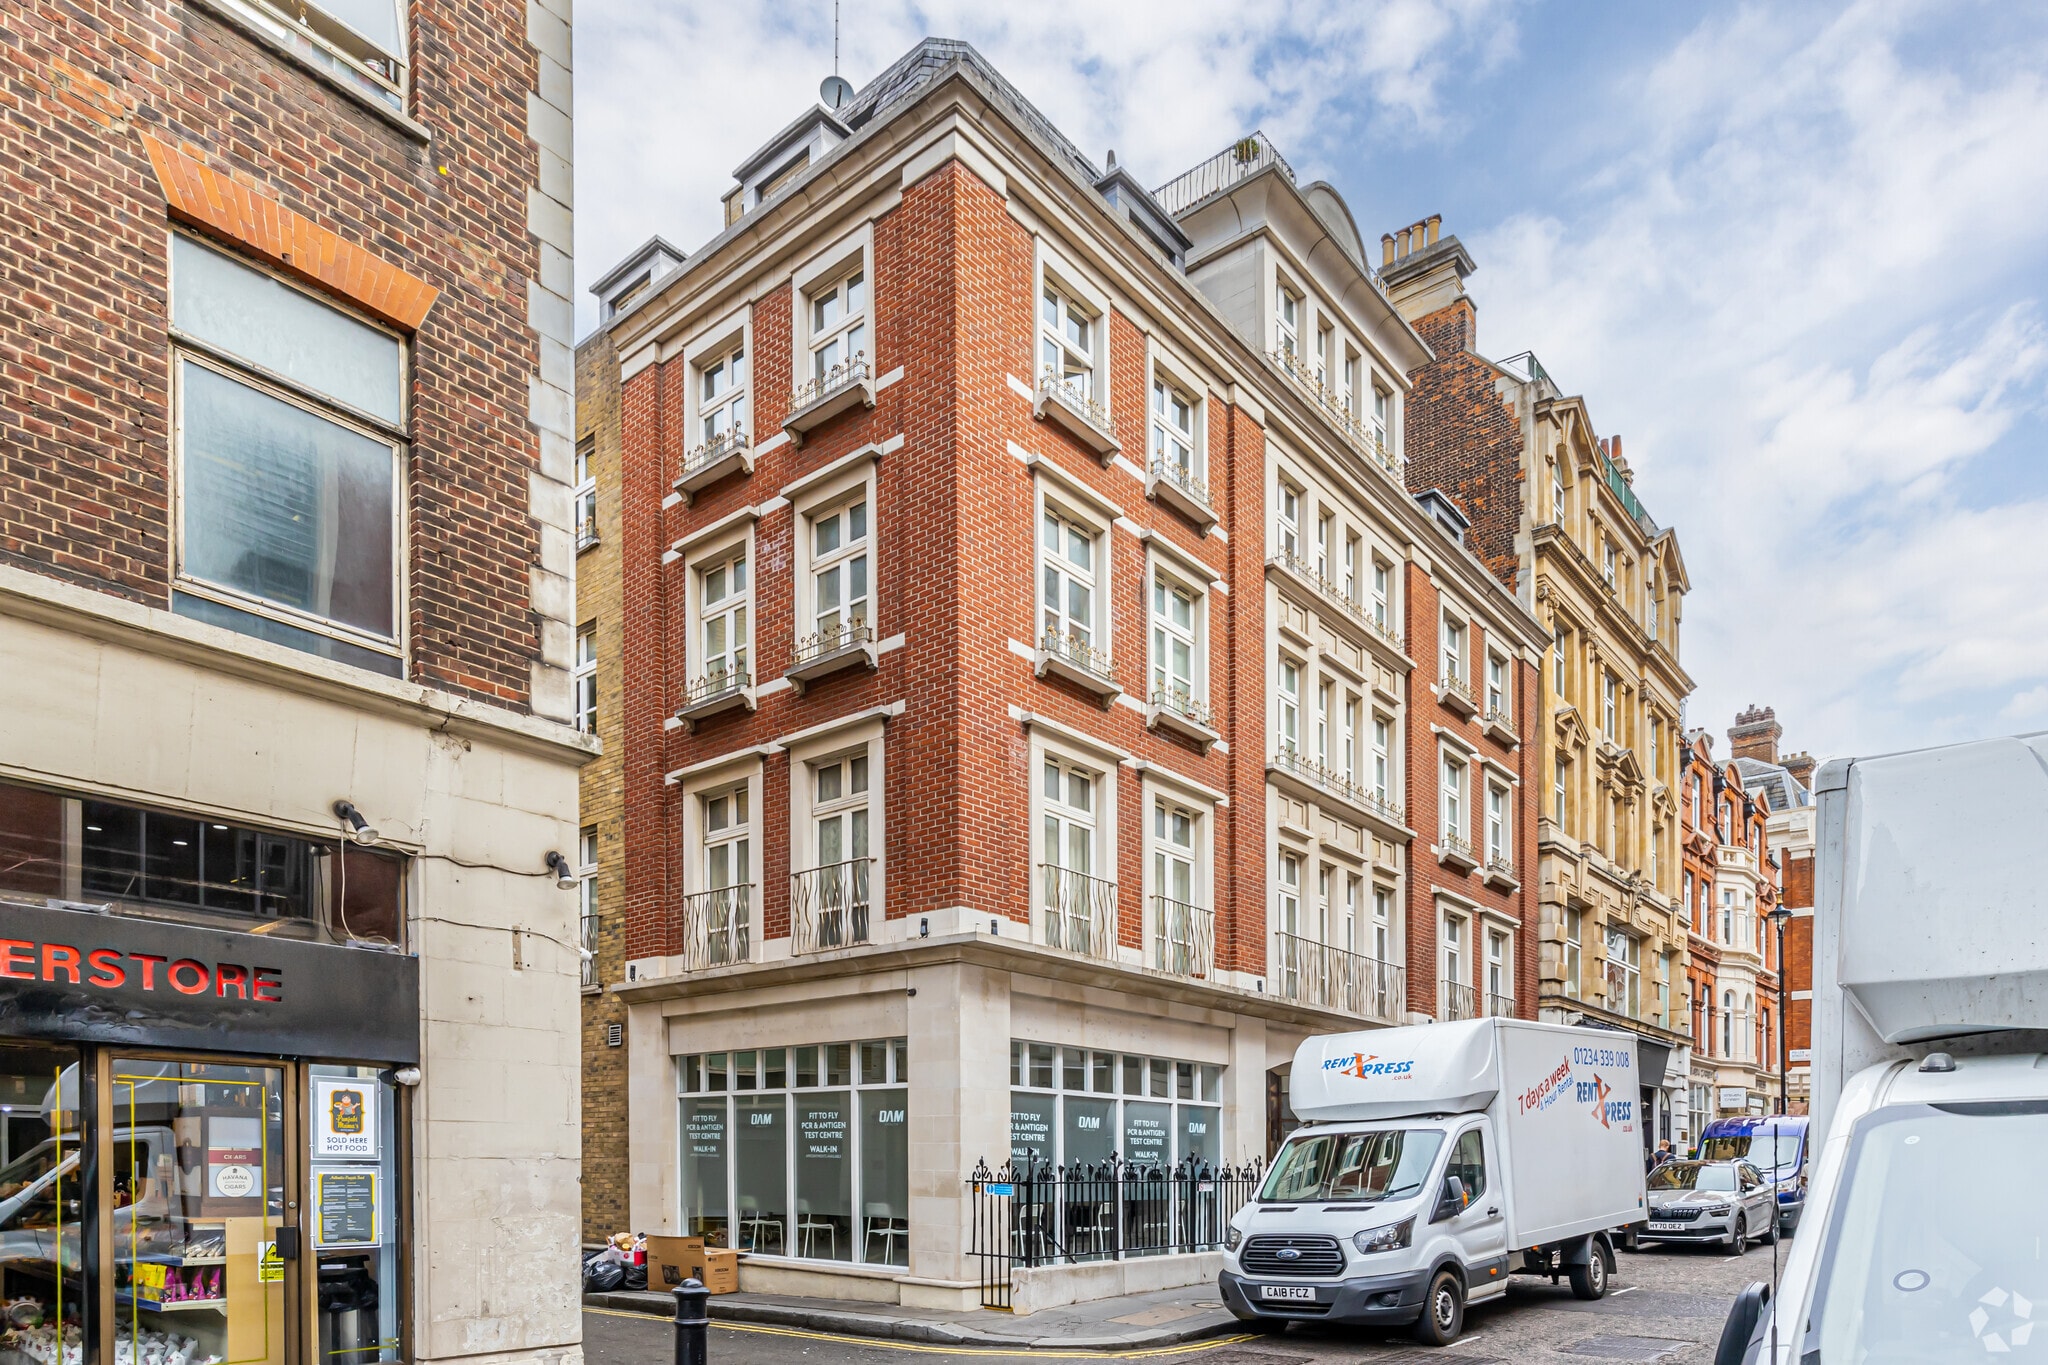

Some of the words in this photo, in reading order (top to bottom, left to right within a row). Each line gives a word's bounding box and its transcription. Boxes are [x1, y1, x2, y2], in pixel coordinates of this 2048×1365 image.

[0, 938, 282, 1002] ERSTORE
[1573, 1047, 1599, 1066] 01234
[1600, 1049, 1614, 1067] 339
[1616, 1051, 1630, 1068] 008
[1518, 1095, 1524, 1116] 7
[1525, 1082, 1545, 1109] days
[1544, 1078, 1550, 1093] a
[1549, 1055, 1571, 1088] week
[1544, 1091, 1558, 1109] Hour
[1557, 1072, 1574, 1097] Rental
[750, 1113, 772, 1125] DAM
[828, 1111, 839, 1119] FLY
[878, 1110, 905, 1123] DAM
[1010, 1112, 1020, 1120] FIT
[1020, 1112, 1029, 1120] TO
[1029, 1113, 1041, 1121] FLY
[819, 1121, 846, 1129] ANTIGEN
[1014, 1122, 1020, 1130] &
[1020, 1123, 1049, 1131] ANTIGEN
[1078, 1116, 1100, 1129] DAM
[1133, 1119, 1141, 1127] FIT
[1150, 1120, 1159, 1128] FLY
[701, 1132, 720, 1140] CENTRE
[804, 1131, 818, 1139] TEST
[819, 1131, 843, 1139] CENTRE
[1011, 1132, 1020, 1140] EST
[1020, 1133, 1046, 1141] CENTRE
[1127, 1128, 1137, 1136] PCR
[1143, 1129, 1166, 1137] ANTIGEN
[1130, 1137, 1142, 1145] TEST
[1142, 1138, 1163, 1146] CENTRE
[345, 1144, 368, 1152] FOOD
[693, 1145, 717, 1153] WALK-IN
[810, 1145, 838, 1153] WALK-IN
[1134, 1150, 1159, 1159] WALK-IN
[1266, 1287, 1288, 1297] CA18
[1289, 1288, 1310, 1298] FCZ
